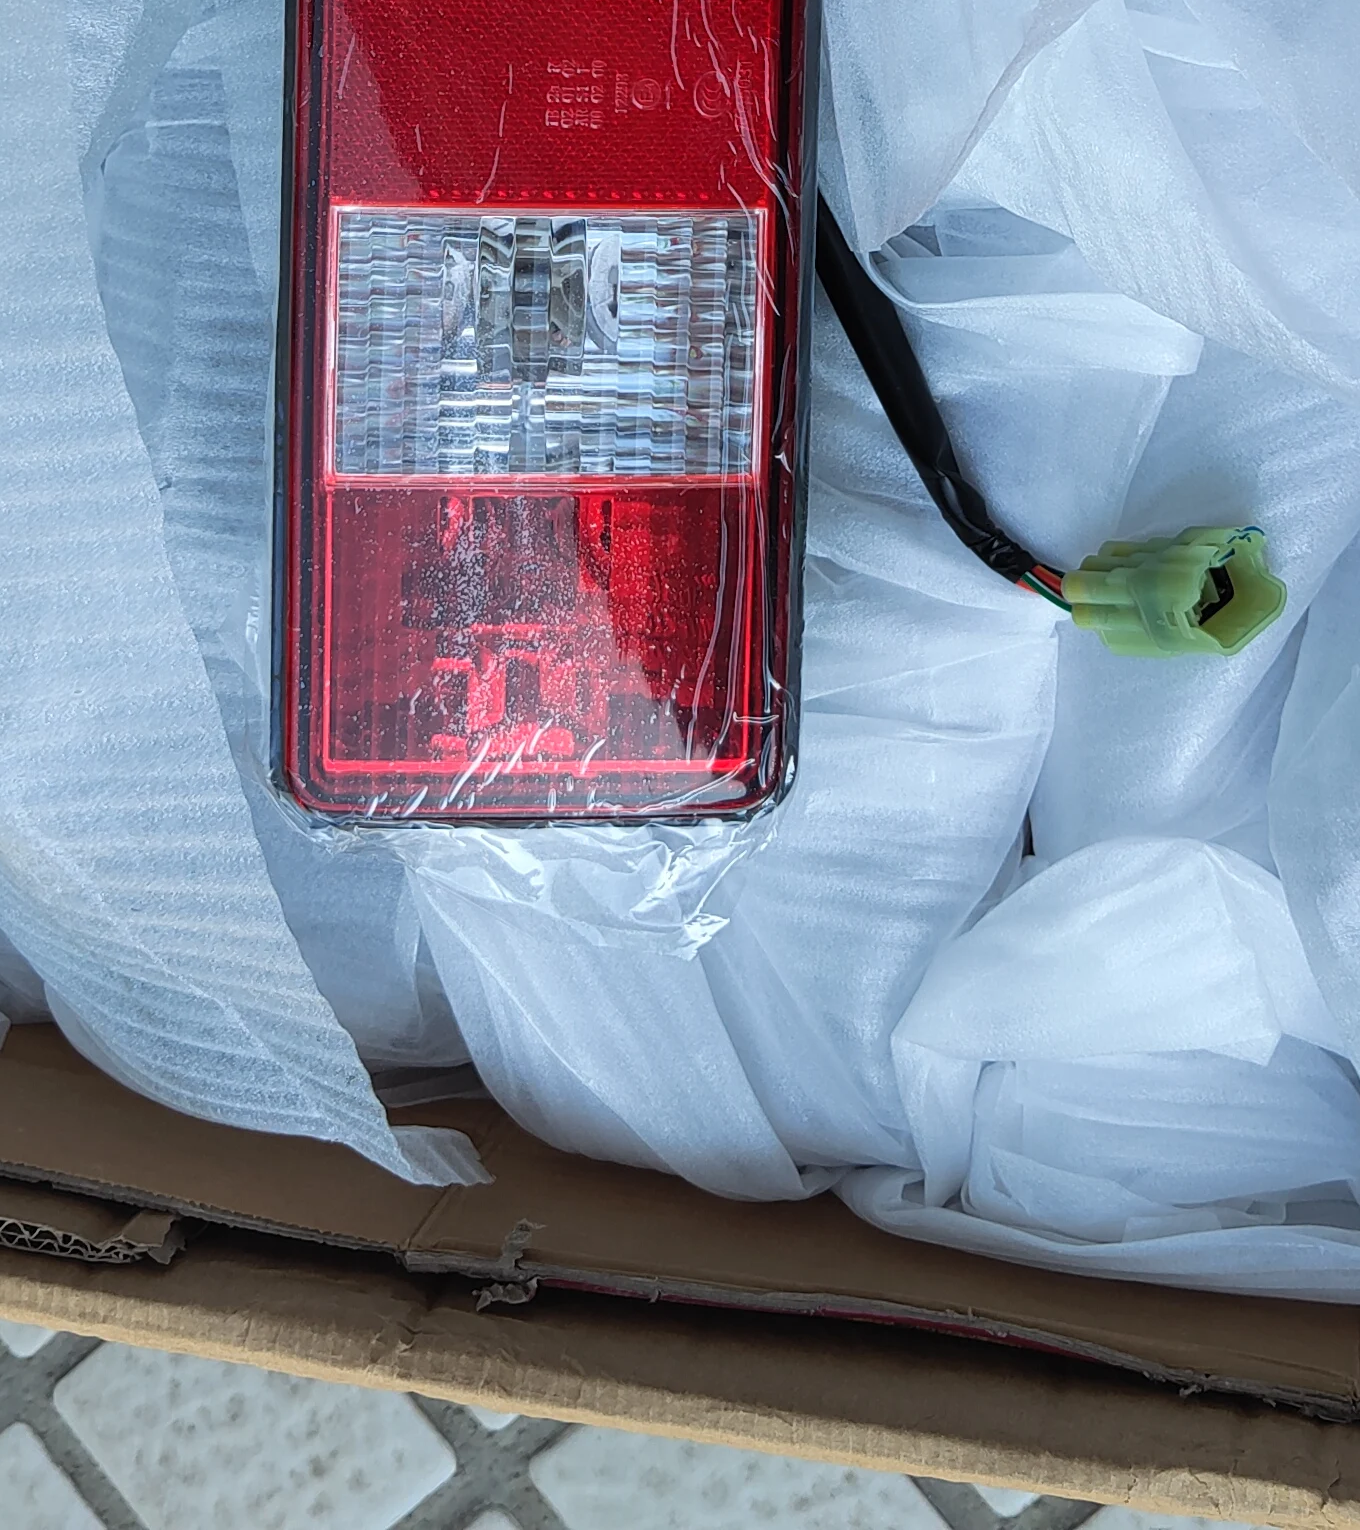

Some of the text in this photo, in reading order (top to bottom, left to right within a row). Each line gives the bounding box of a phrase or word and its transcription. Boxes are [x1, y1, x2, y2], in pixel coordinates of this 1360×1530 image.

[560, 86, 575, 104] 01
[590, 84, 605, 104] 02
[559, 107, 574, 129] 02
